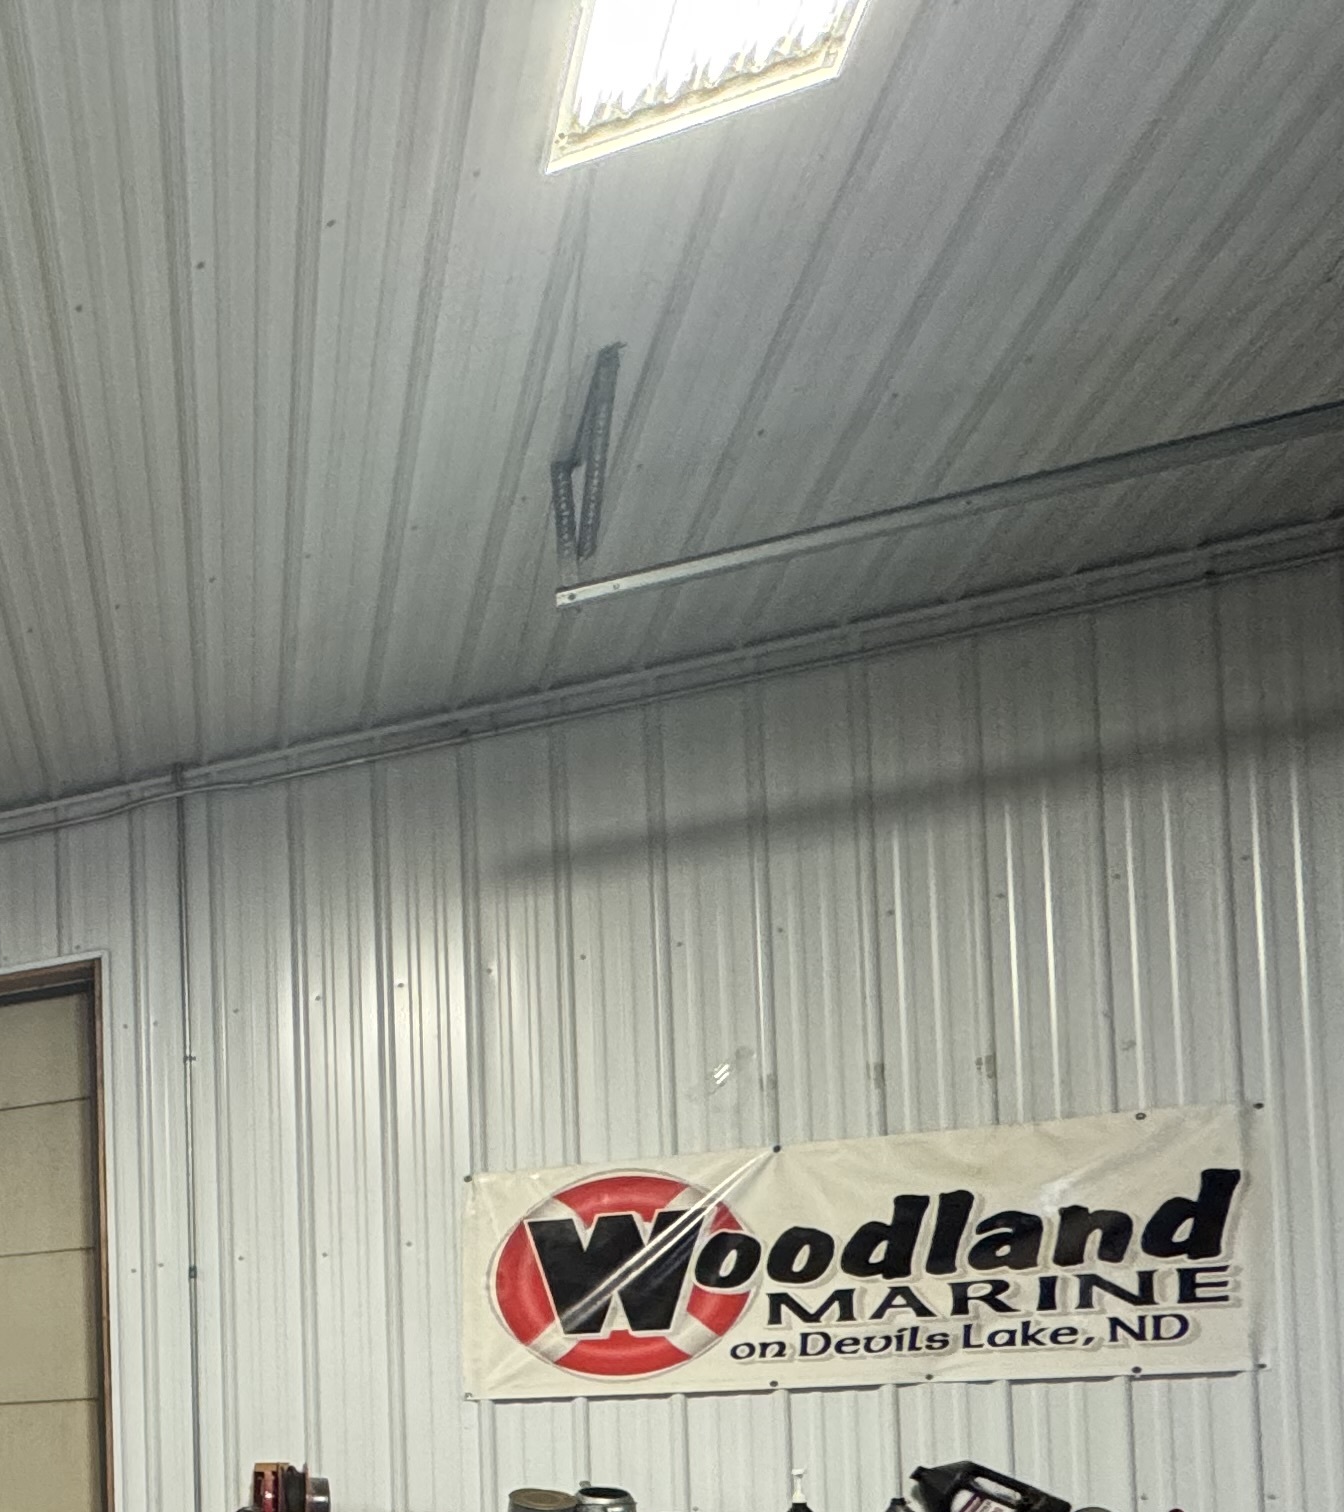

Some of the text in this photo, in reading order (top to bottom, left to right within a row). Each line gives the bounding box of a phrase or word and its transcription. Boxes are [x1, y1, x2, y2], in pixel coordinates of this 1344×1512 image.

[527, 1168, 1240, 1335] Woodland
[766, 1265, 1230, 1326] MARINE
[729, 1313, 1191, 1361] on Devils Lake, ND
